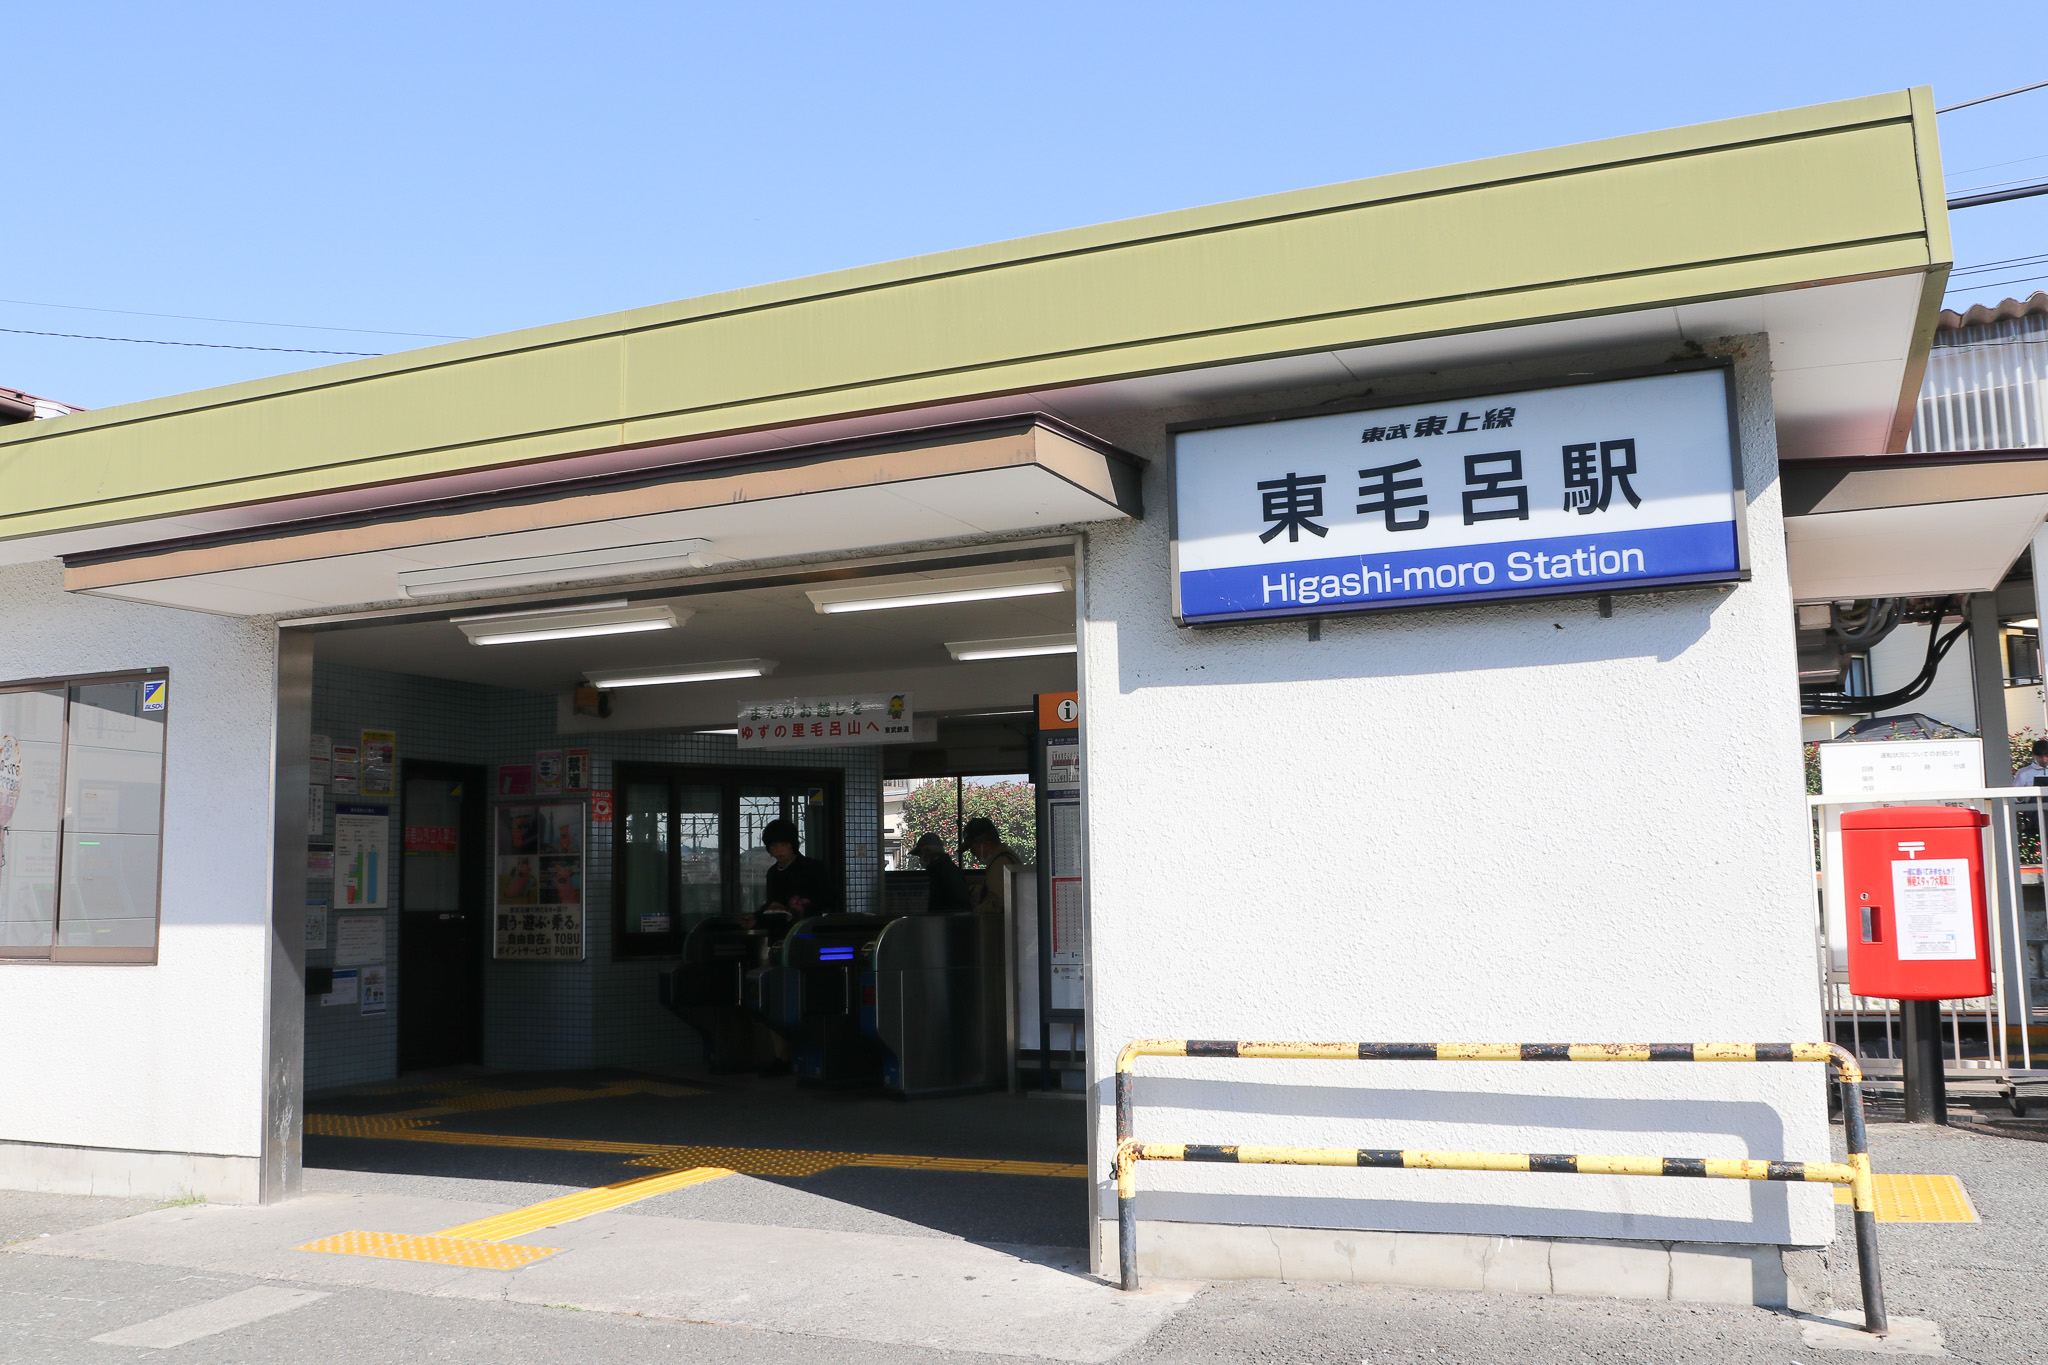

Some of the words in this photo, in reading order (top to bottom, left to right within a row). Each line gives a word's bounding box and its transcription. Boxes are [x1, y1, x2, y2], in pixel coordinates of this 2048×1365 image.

[1361, 407, 1516, 443] 東武東上線
[1257, 438, 1641, 543] 東毛呂駅
[1261, 561, 1495, 605] Higashi-moro
[1508, 544, 1644, 582] Station
[741, 720, 880, 740] ゆずの里毛呂山へ
[885, 726, 910, 734] 東武鉄道
[567, 756, 581, 789] 禁煙
[554, 933, 580, 945] TOBU
[554, 946, 579, 956] POINT
